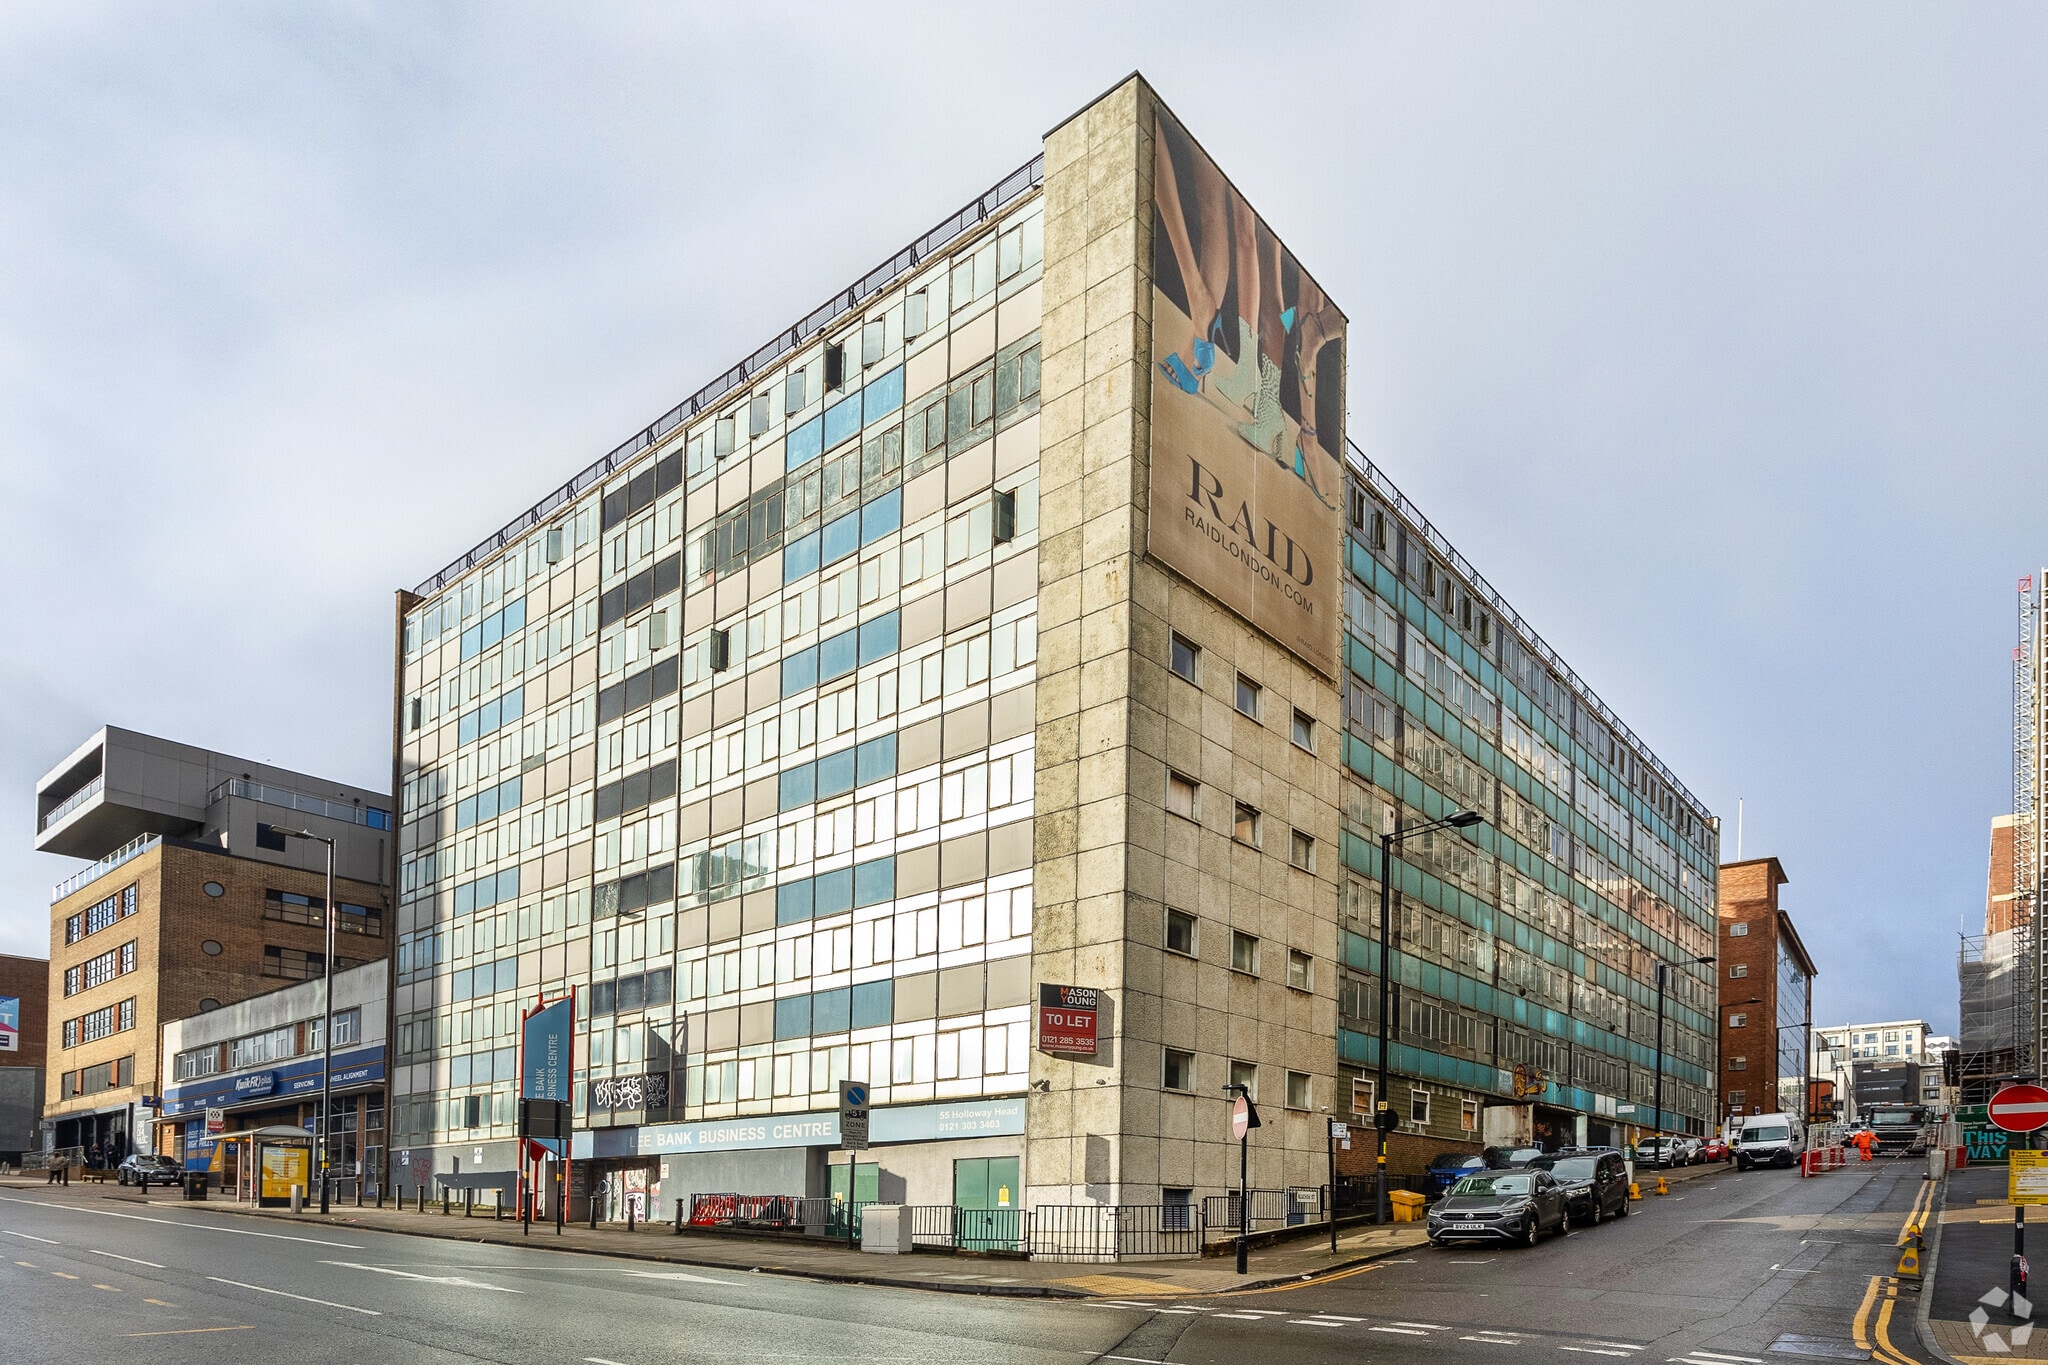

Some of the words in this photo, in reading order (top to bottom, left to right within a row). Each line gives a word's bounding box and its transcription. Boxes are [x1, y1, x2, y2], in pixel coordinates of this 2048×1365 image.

[1185, 454, 1314, 588] RAID
[1184, 506, 1314, 615] RAIDLONDON.COM
[1060, 987, 1097, 998] MASON
[1061, 996, 1097, 1006] YOUNG
[1046, 1013, 1063, 1026] TO
[1067, 1015, 1091, 1028] LET
[1041, 1035, 1057, 1044] 0121
[1059, 1036, 1074, 1045] 285
[1075, 1037, 1095, 1046] 3535
[547, 1034, 558, 1067] CENTRE
[293, 1080, 315, 1089] SERVICING
[343, 1069, 369, 1080] ALIGNMENT
[535, 1068, 545, 1091] BANK
[939, 1111, 950, 1120] 55
[952, 1108, 992, 1119] Holloway
[994, 1106, 1018, 1116] Head
[939, 1122, 959, 1132] 0121
[961, 1121, 977, 1131] 303
[979, 1119, 1000, 1129] 3403
[629, 1132, 651, 1149] LEE
[657, 1131, 692, 1147] BANK
[699, 1126, 766, 1145] BUSINESS
[773, 1121, 832, 1140] CENTRE
[1963, 1130, 2008, 1146] THIS
[1966, 1144, 2007, 1158] WAY
